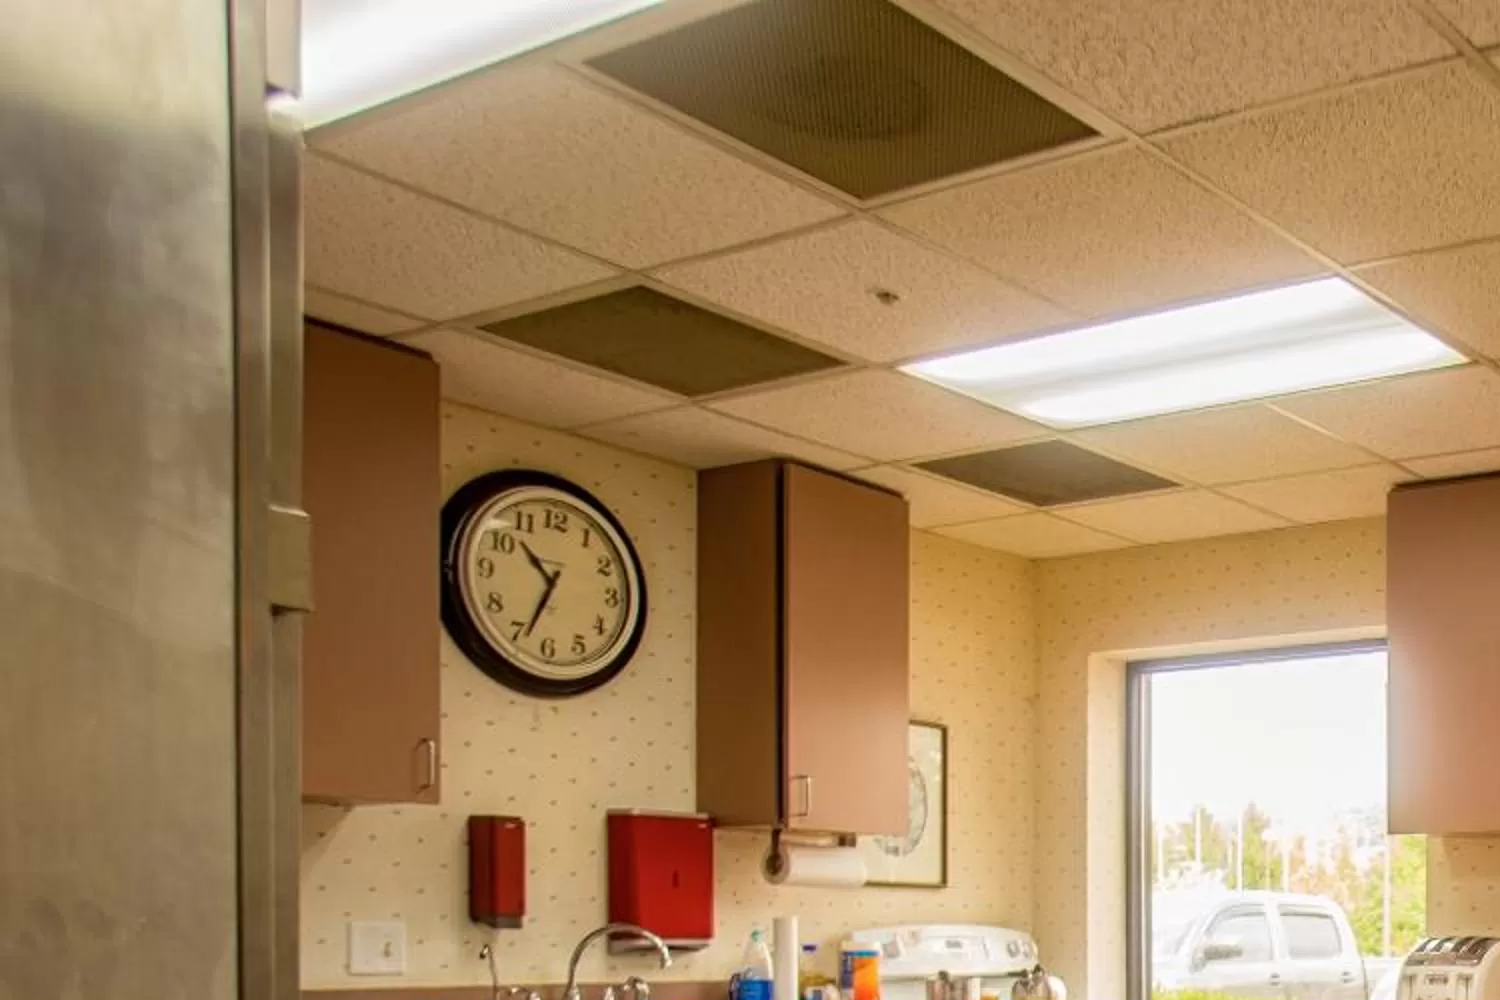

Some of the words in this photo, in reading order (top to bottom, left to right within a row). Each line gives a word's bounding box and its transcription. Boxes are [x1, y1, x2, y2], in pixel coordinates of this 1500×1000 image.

[515, 511, 535, 534] 11
[544, 509, 568, 533] 12
[490, 531, 515, 554] 10
[581, 527, 590, 548] 1
[477, 557, 495, 579] 9
[597, 556, 612, 577] 2
[486, 592, 504, 613] 8
[604, 588, 619, 608] 3
[510, 621, 525, 642] 7
[592, 613, 606, 636] 4
[540, 638, 556, 659] 6
[571, 634, 586, 655] 5
